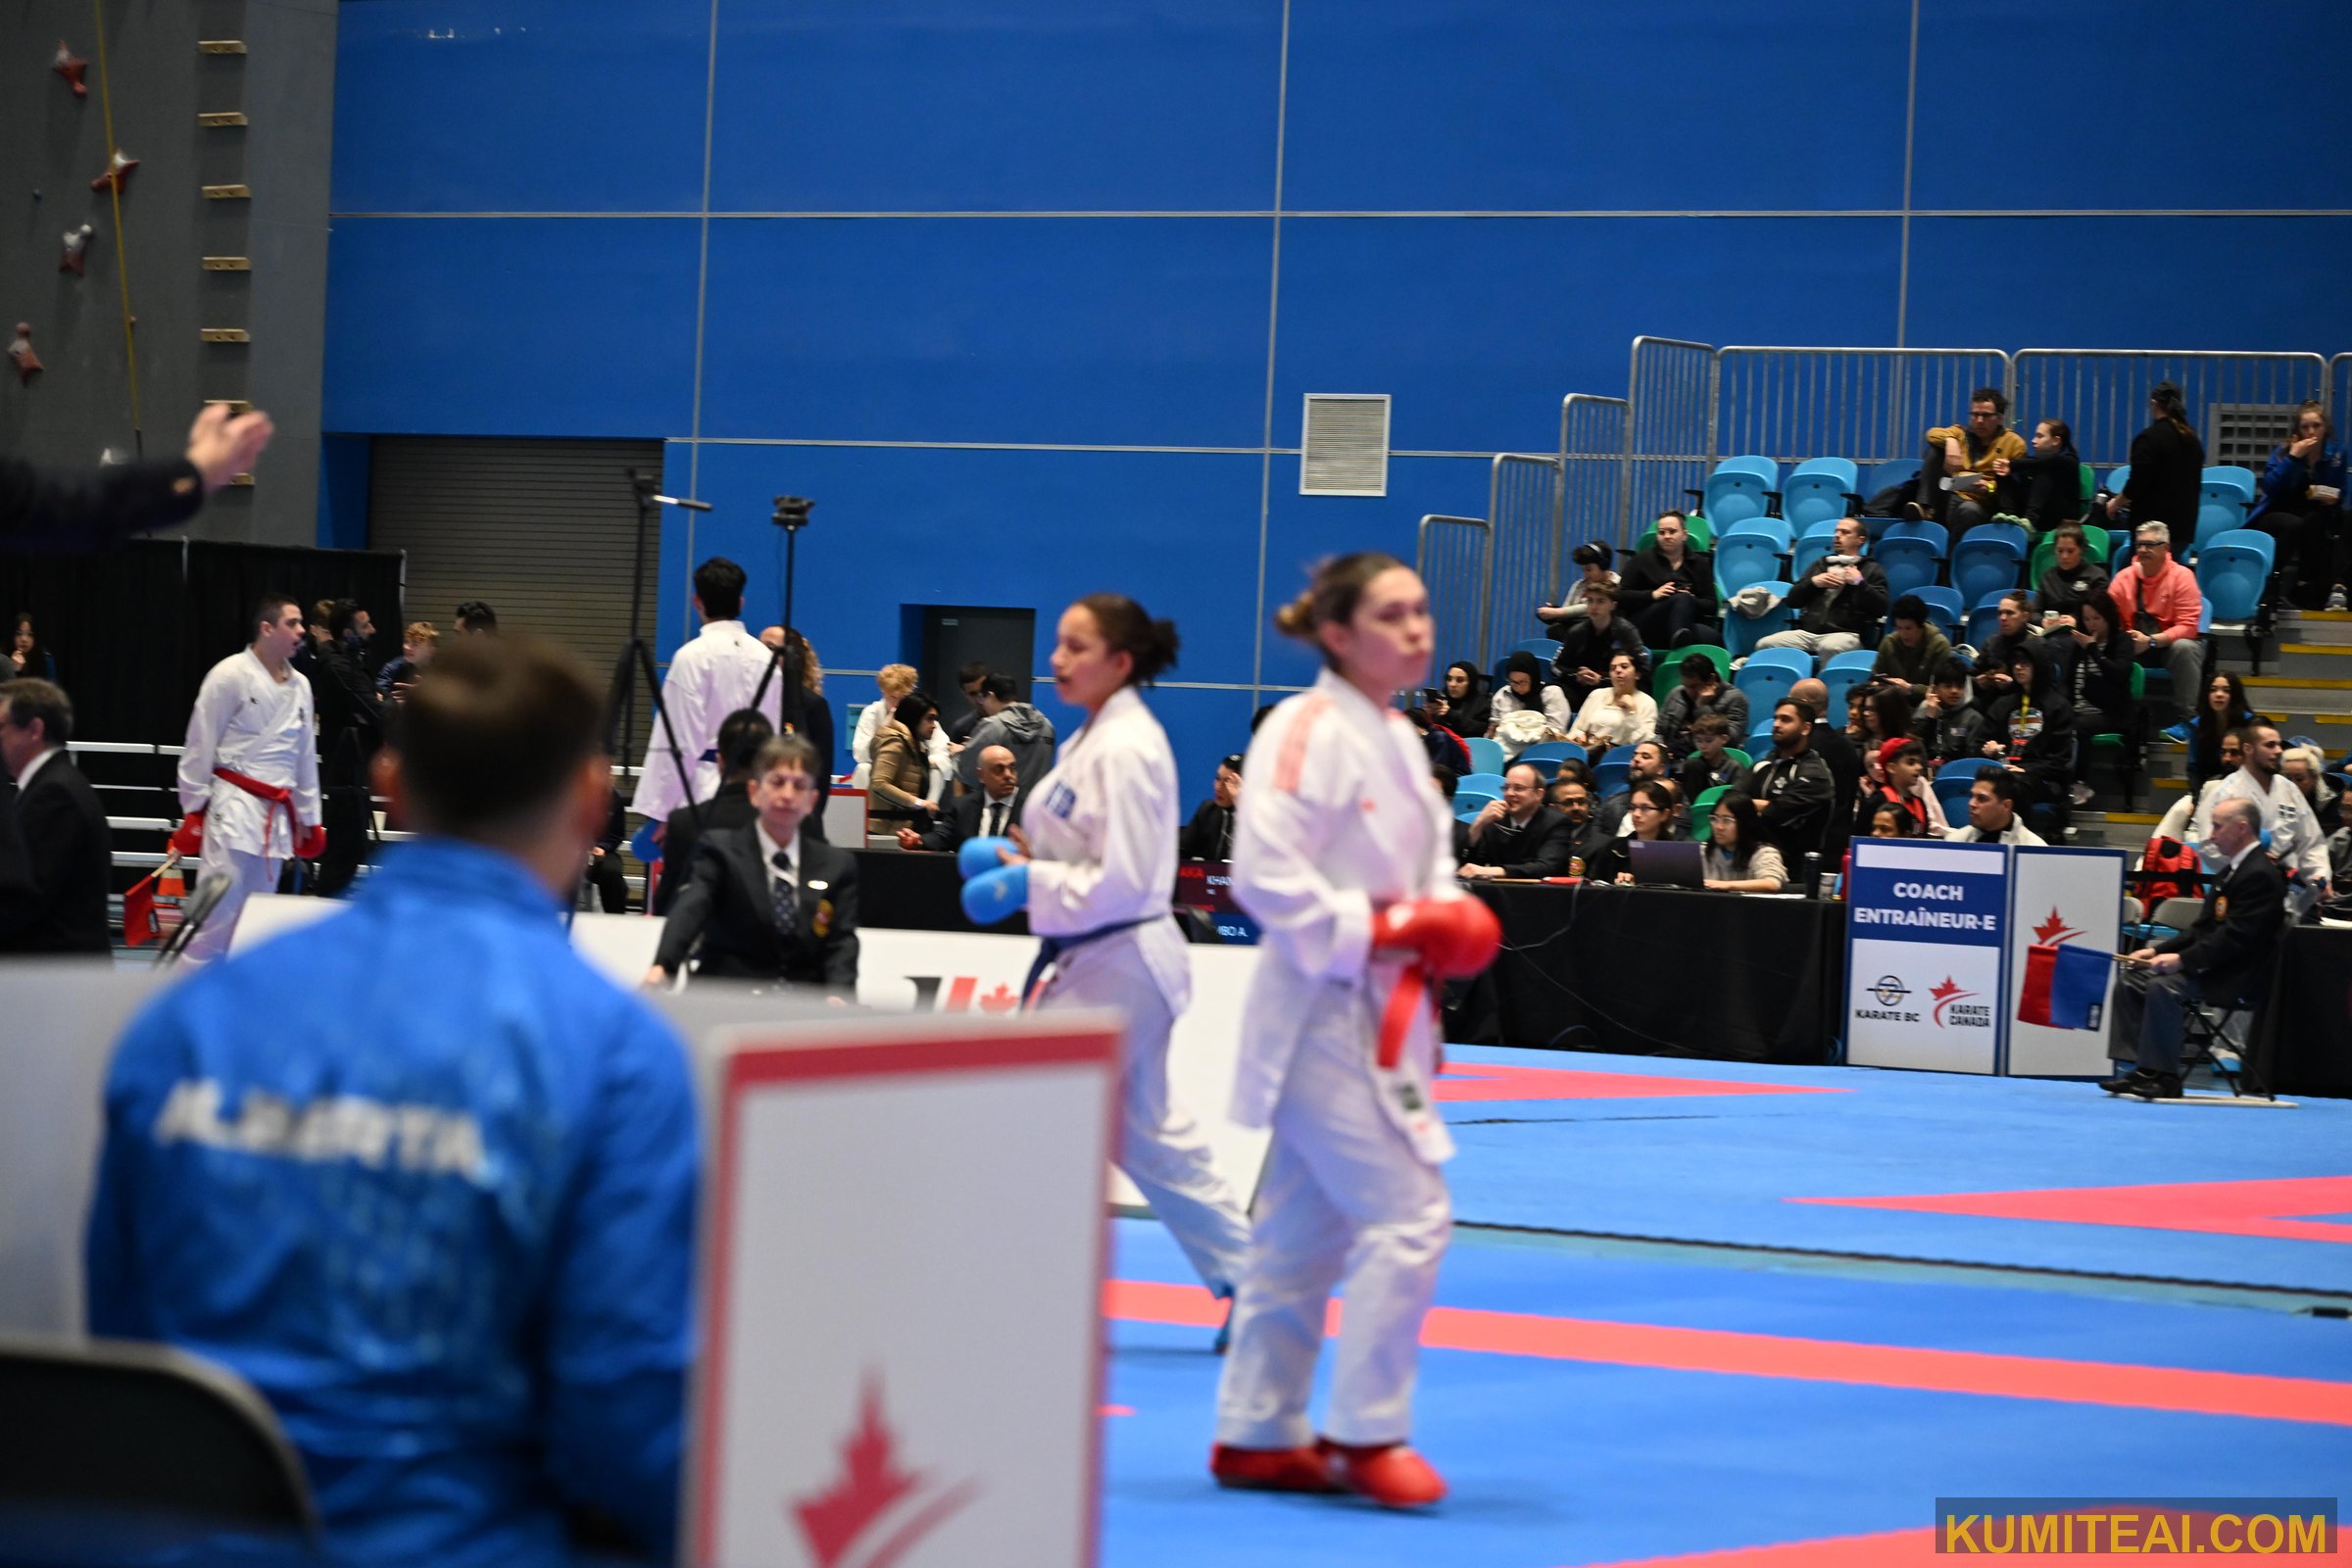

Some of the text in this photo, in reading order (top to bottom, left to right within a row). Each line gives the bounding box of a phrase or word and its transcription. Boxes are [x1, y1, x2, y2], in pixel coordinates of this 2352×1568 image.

[1892, 882, 1965, 902] COACH
[1855, 1009, 1921, 1022] KARATE BC
[1949, 1004, 1990, 1016] KARATE
[1949, 1015, 1990, 1028] CANADA
